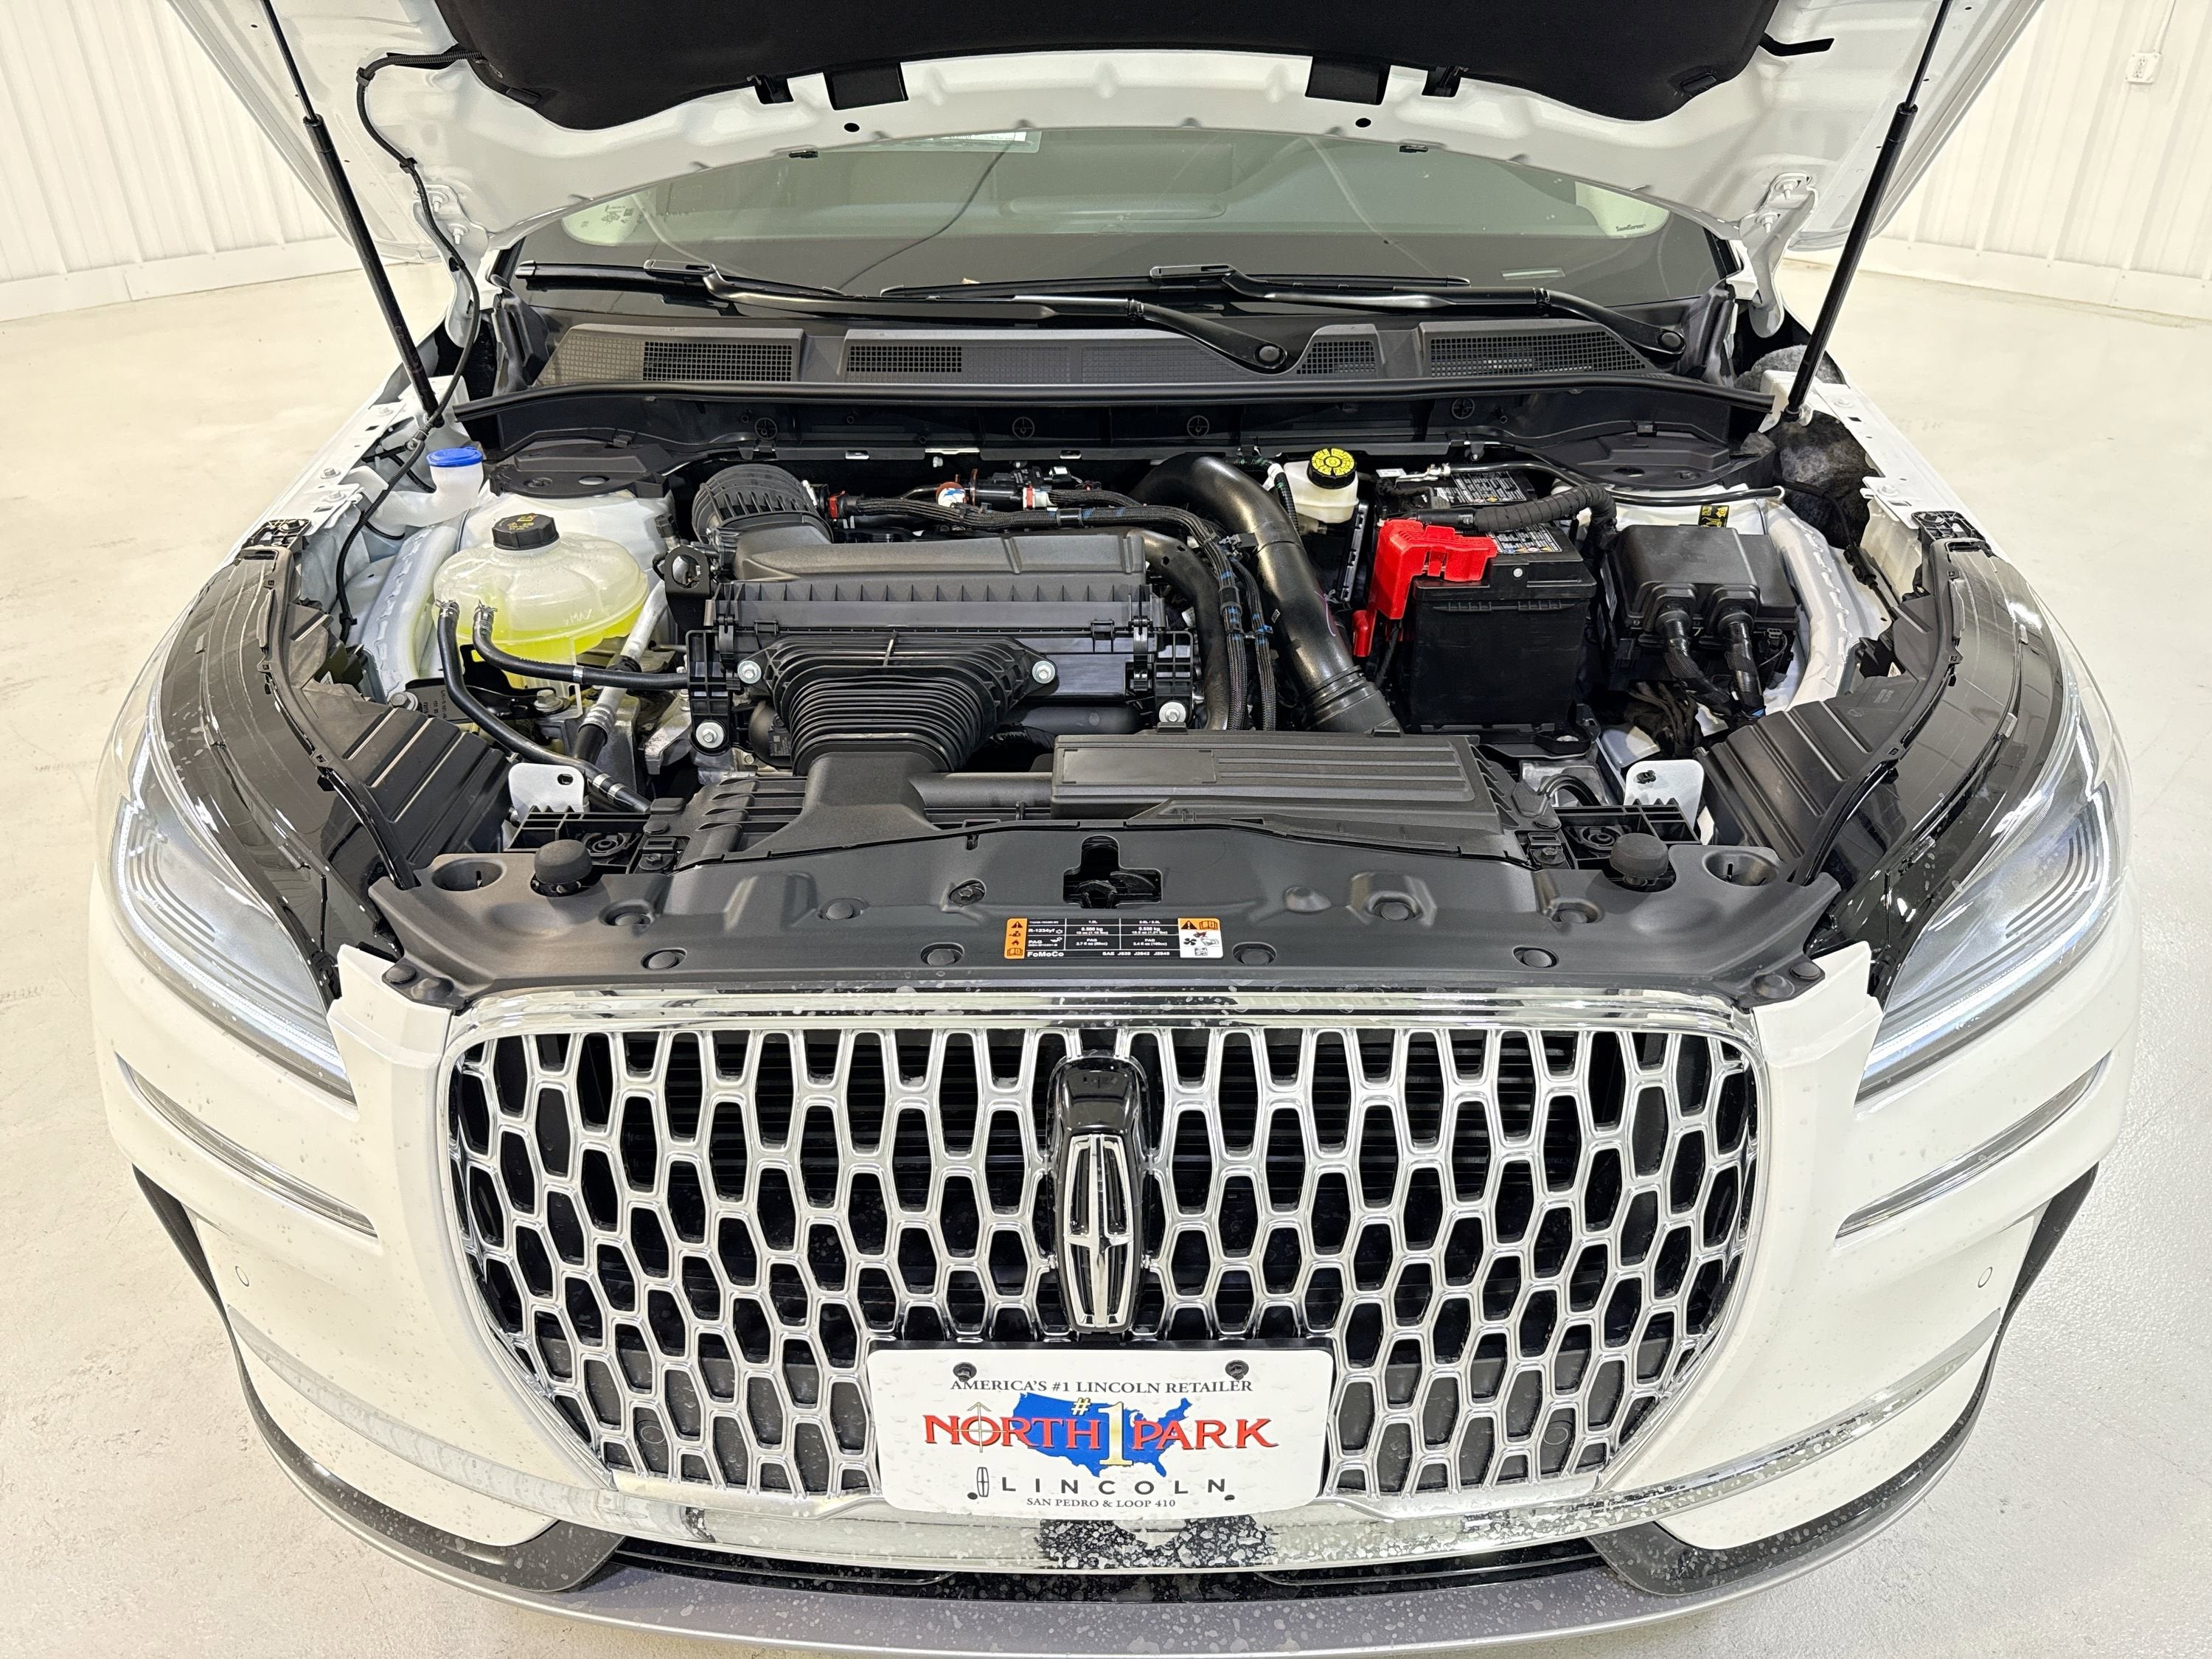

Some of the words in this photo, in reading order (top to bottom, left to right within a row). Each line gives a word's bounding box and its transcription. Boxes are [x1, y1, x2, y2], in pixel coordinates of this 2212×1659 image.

[950, 1380, 1048, 1391] AMERICA'S
[1051, 1381, 1069, 1392] #1
[1076, 1381, 1160, 1393] LINCOLN
[1165, 1380, 1253, 1394] RETAILER
[922, 1414, 1102, 1450] NORTH
[1133, 1418, 1280, 1450] PARK
[1001, 1476, 1225, 1495] LINCOLN
[1026, 1498, 1051, 1506] SAN
[1055, 1498, 1099, 1507] PEDRO
[1102, 1499, 1113, 1508] &
[1116, 1499, 1152, 1508] LOOP
[1155, 1498, 1175, 1507] 410
